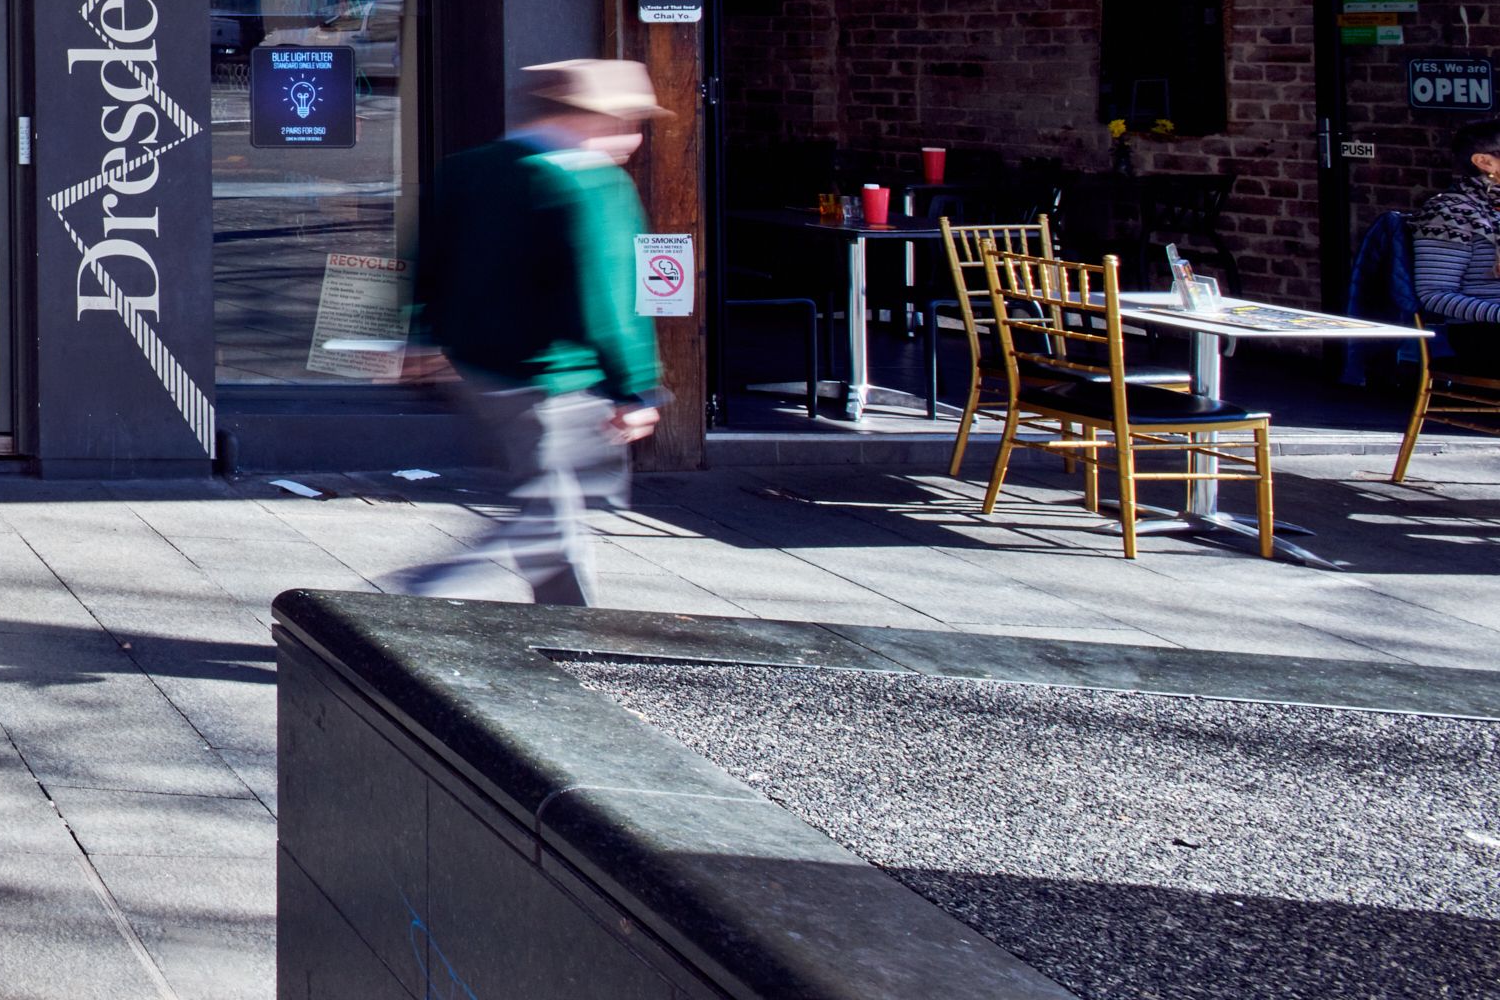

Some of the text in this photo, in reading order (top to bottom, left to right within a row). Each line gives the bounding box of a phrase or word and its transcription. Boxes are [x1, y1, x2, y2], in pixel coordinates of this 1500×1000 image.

[272, 52, 333, 62] BLUE LIGHT FILTER
[273, 62, 332, 70] STANDARD SINGLE VISION
[1414, 62, 1488, 74] YES, We are
[1413, 77, 1490, 104] OPEN
[281, 126, 286, 134] 2
[286, 126, 302, 135] PAIRS
[302, 126, 313, 135] FOR
[1342, 144, 1373, 156] PUSH
[329, 254, 406, 272] RECYCLED
